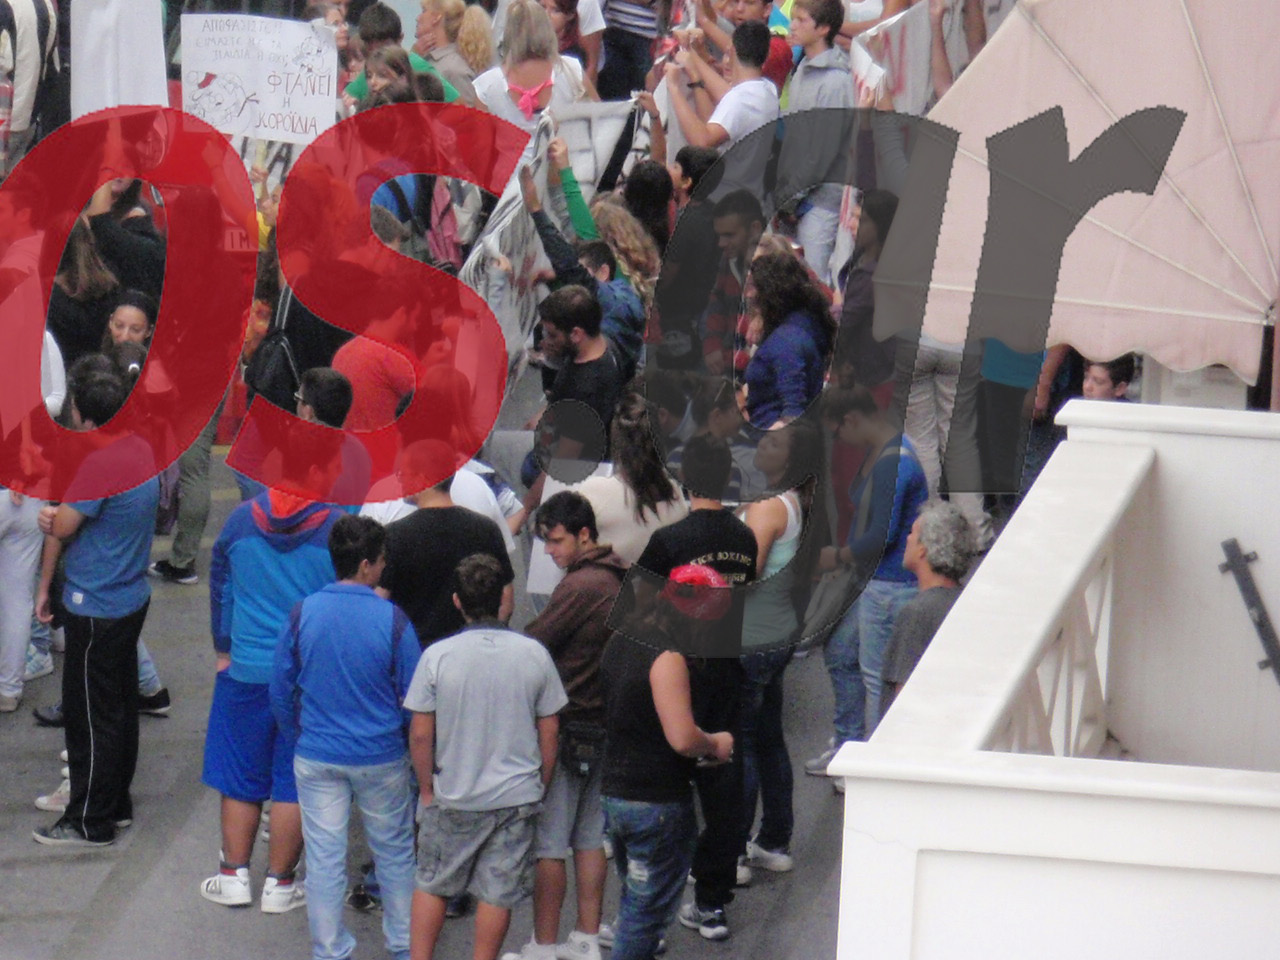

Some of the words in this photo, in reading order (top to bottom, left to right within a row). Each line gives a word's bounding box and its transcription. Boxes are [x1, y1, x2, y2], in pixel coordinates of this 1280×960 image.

[268, 71, 331, 96] ΦΤΑΝΕΙ
[283, 97, 291, 108] Η
[717, 551, 752, 566] BOXING
